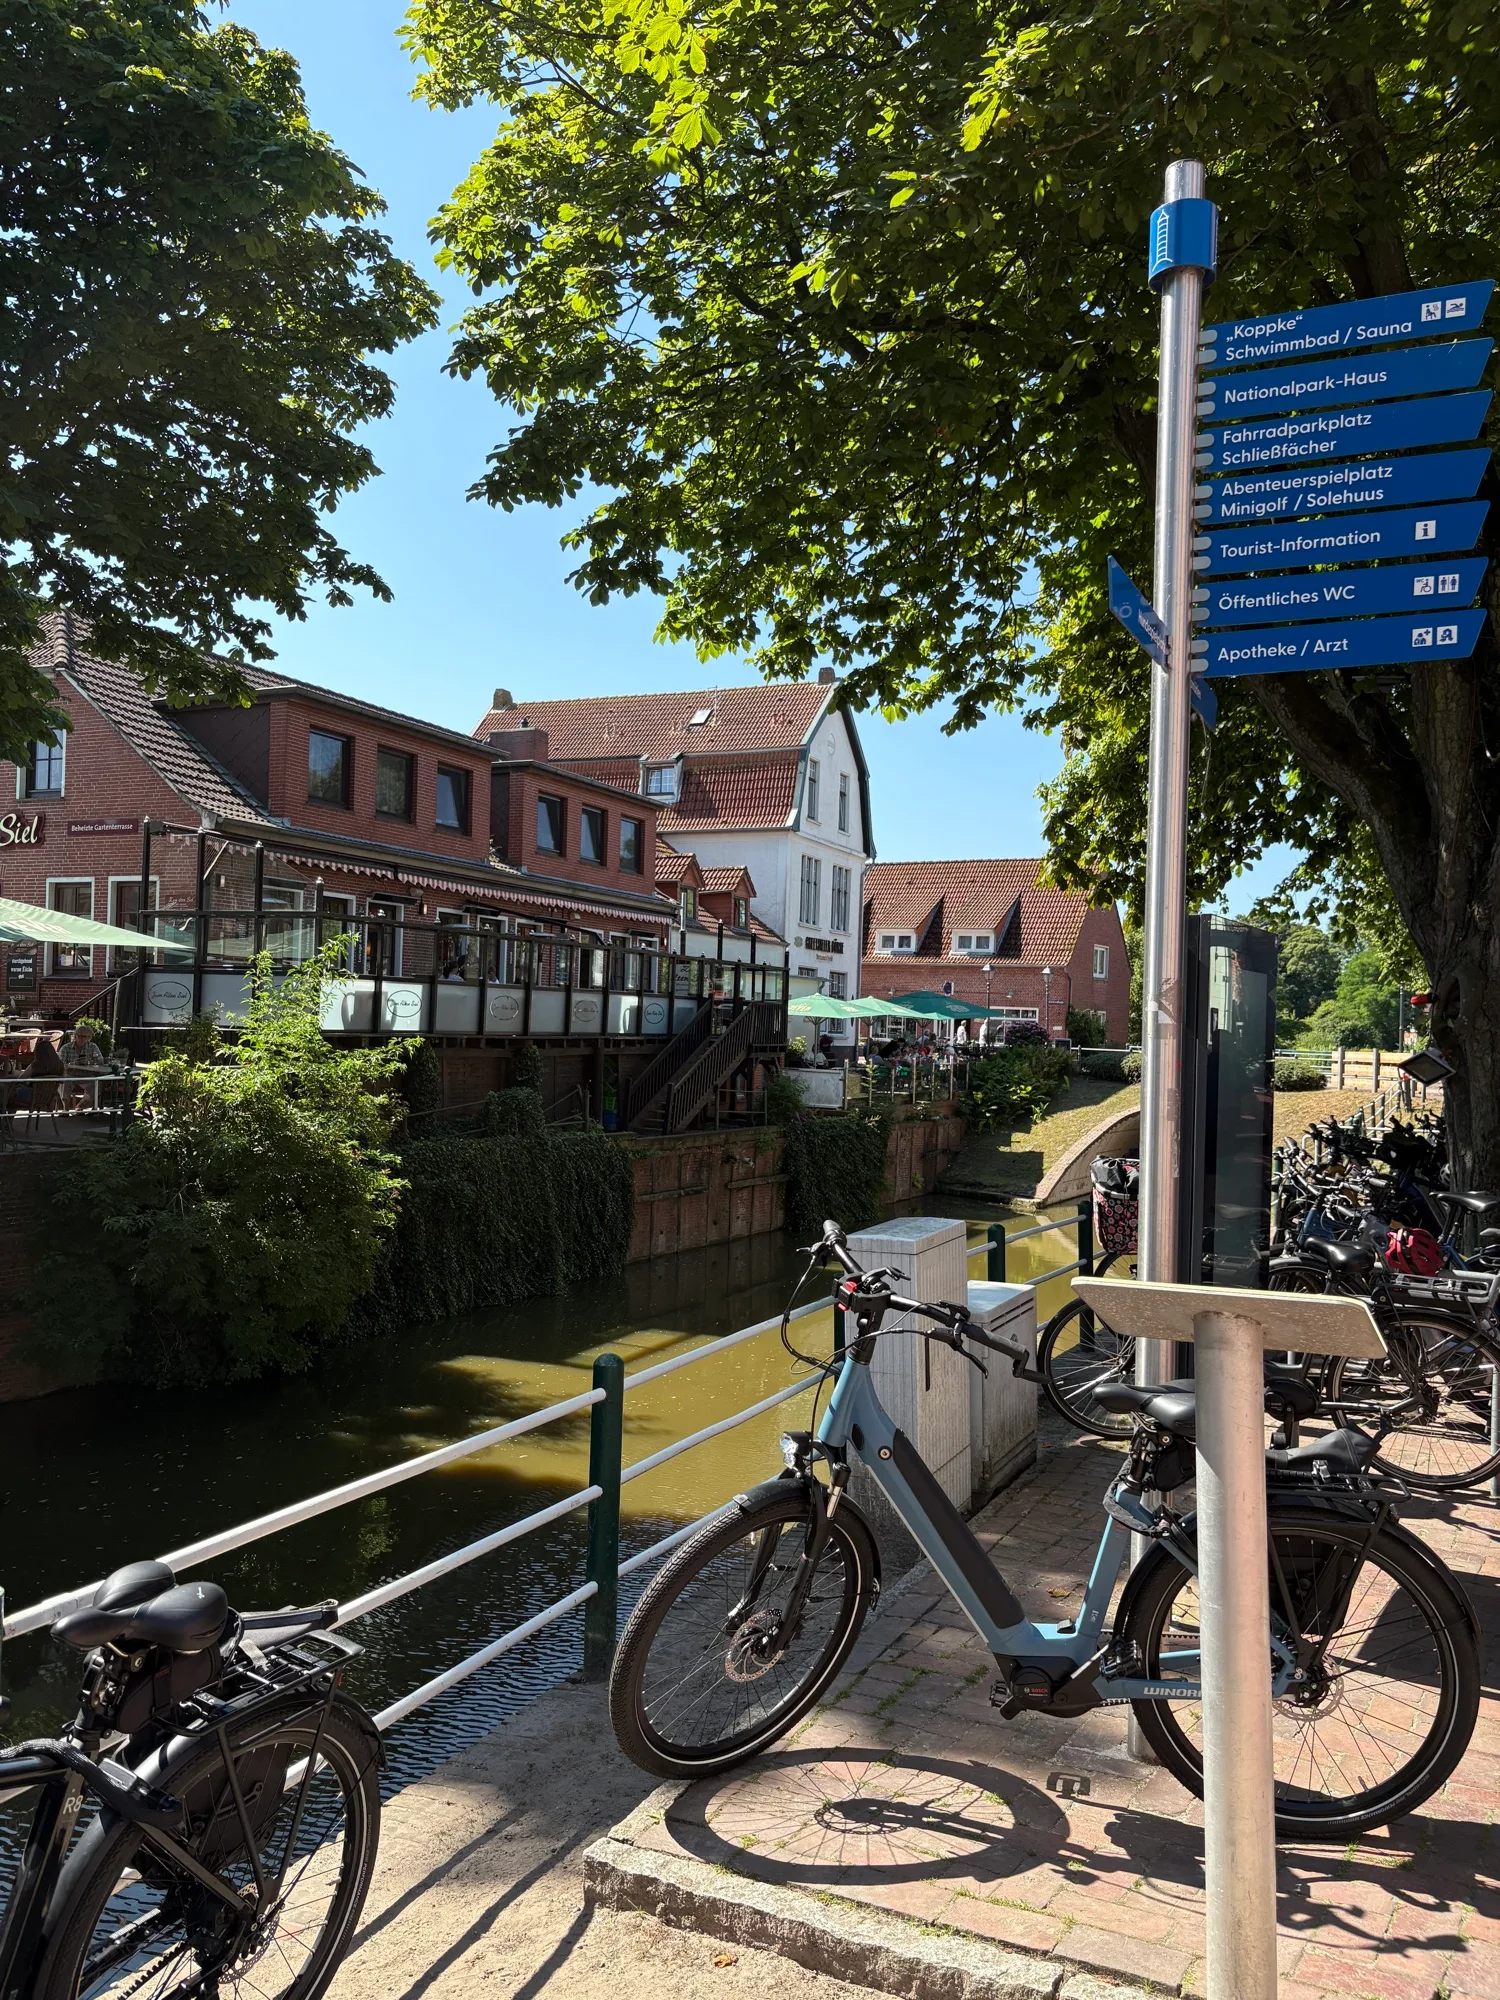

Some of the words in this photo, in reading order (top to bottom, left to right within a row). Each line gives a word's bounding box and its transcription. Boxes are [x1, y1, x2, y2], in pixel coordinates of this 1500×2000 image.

[1225, 331, 1340, 362] Schwimmbad
[1344, 328, 1352, 344] /
[1356, 320, 1413, 339] Sauna
[1224, 369, 1388, 404] Nationalpark-Haus
[1223, 412, 1372, 445] Fahrradparkplatz
[1222, 438, 1337, 466] Schließfächer
[1221, 464, 1393, 498] Abenteuerspielplatz
[1221, 497, 1288, 520] Minigolf
[1294, 494, 1303, 511] /
[1306, 487, 1384, 508] Solehuus
[1221, 529, 1381, 559] Tourist-Information
[1218, 588, 1319, 611] Öffentliches
[1324, 585, 1355, 601] WC
[1218, 642, 1297, 662] Apotheke
[1300, 640, 1309, 656] /
[1313, 637, 1349, 654] Arzt
[0, 813, 38, 847] Siel
[71, 824, 94, 832] Beheizte
[94, 823, 133, 831] Gartenterrasse
